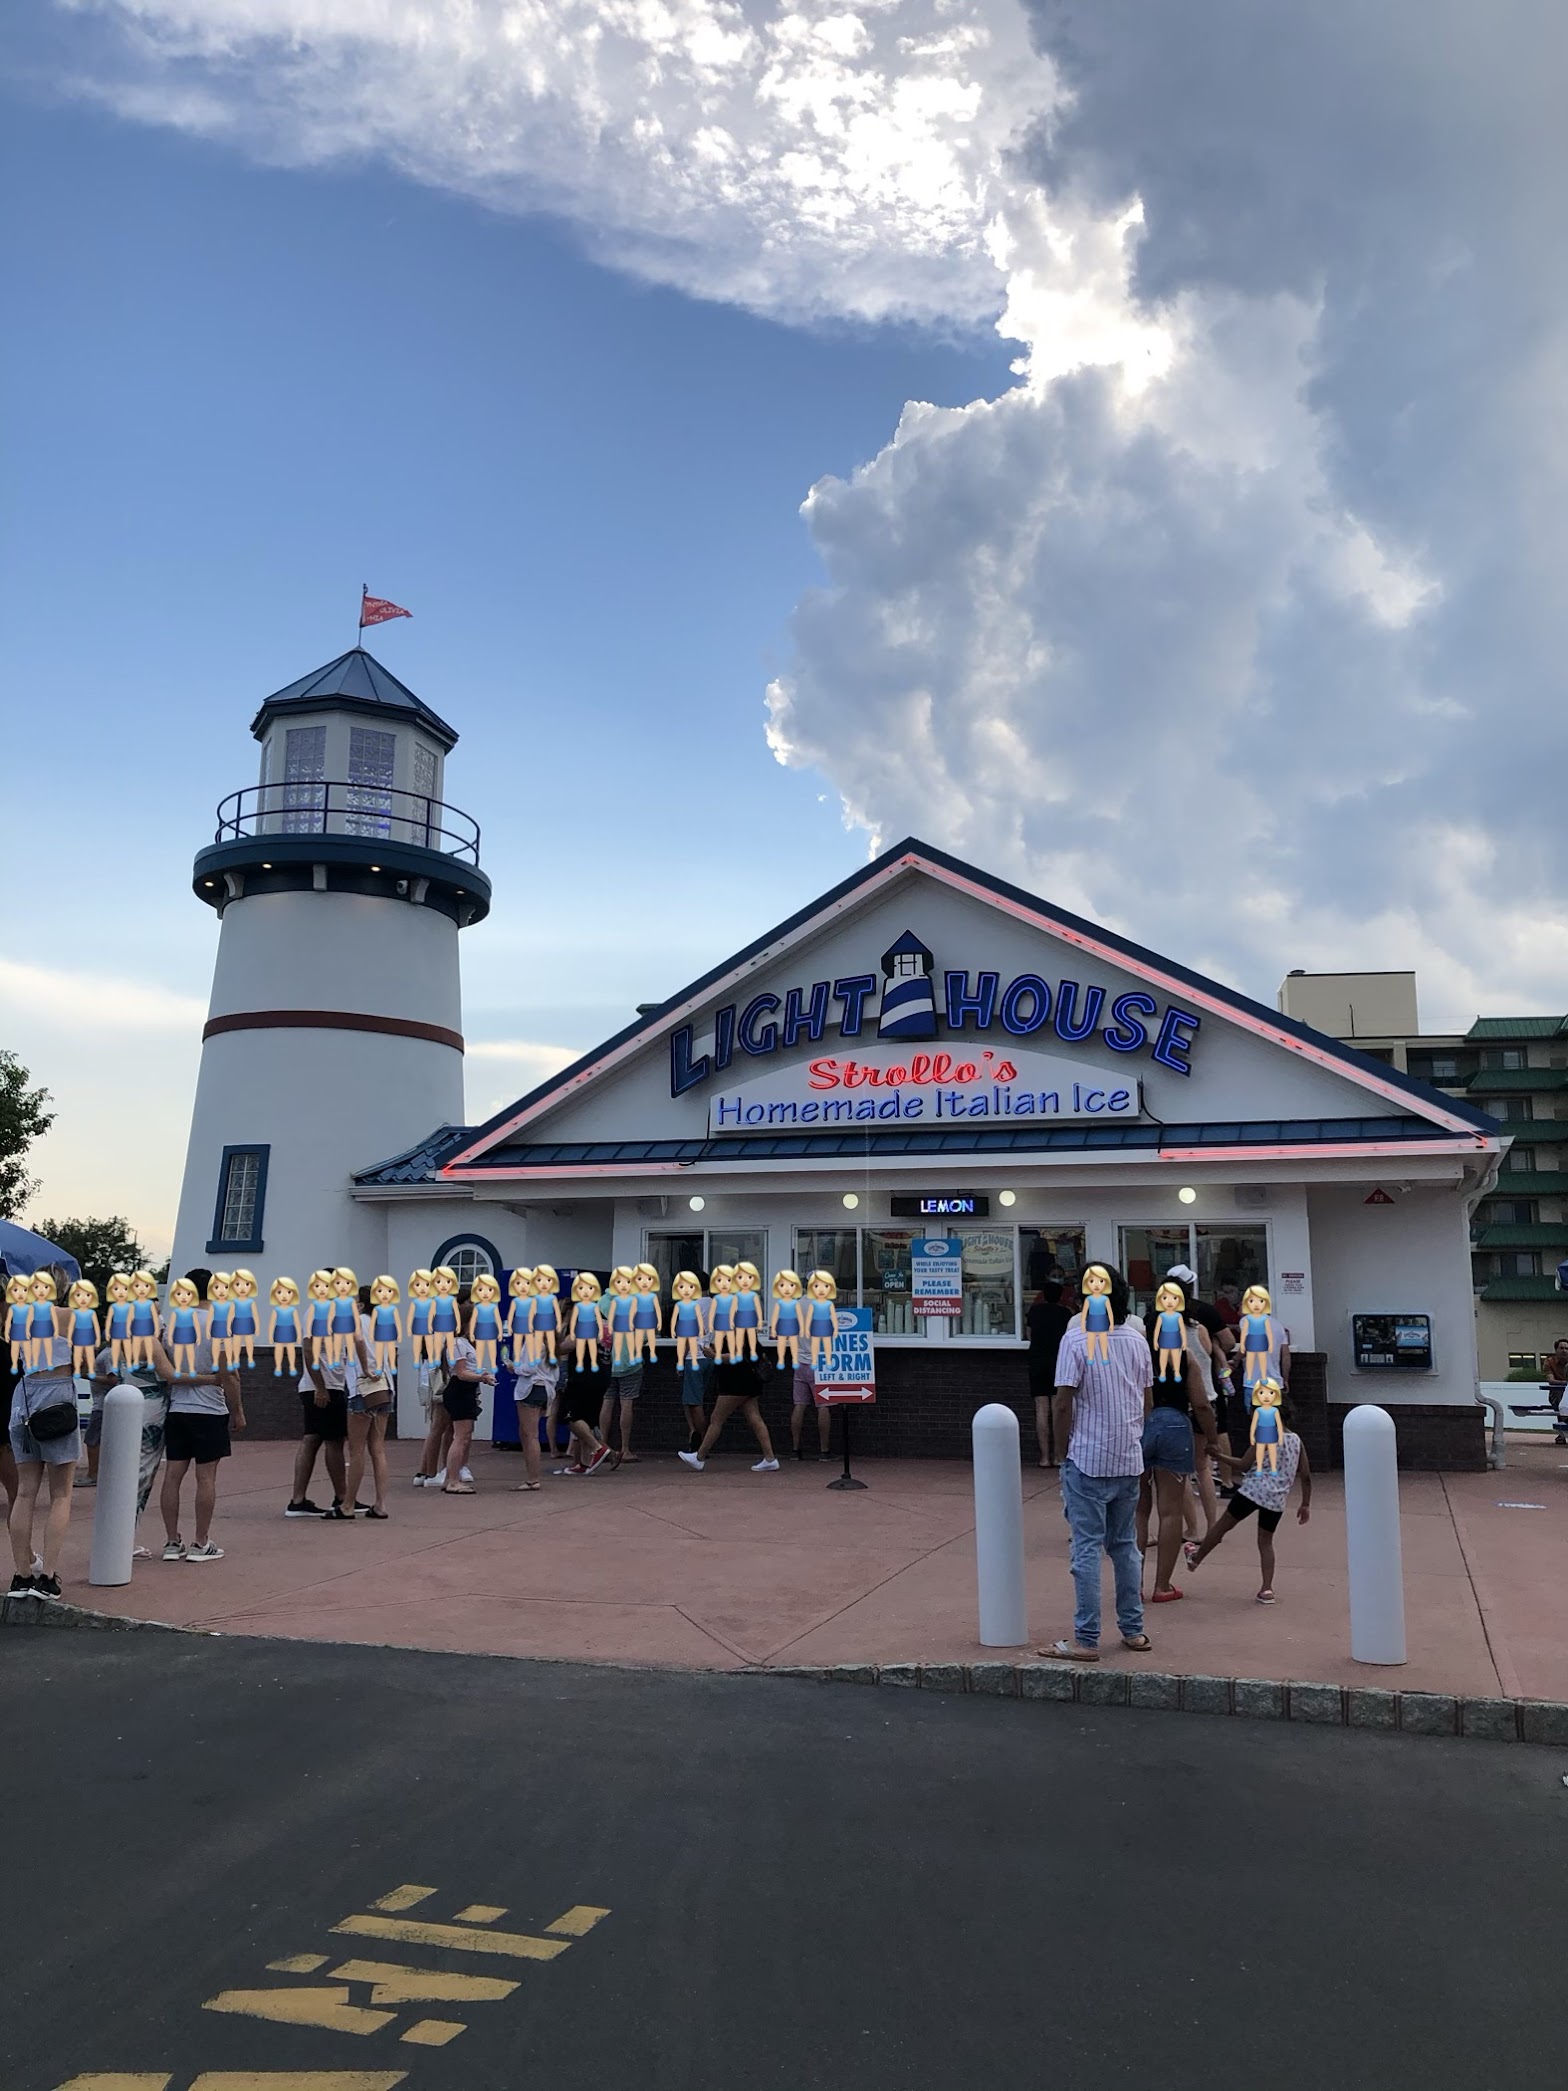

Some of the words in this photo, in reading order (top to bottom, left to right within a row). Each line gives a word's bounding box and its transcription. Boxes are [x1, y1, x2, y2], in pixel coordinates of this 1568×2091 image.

[671, 973, 876, 1099] LIGHT
[944, 970, 1201, 1077] HOUSE
[808, 1051, 1018, 1090] Strollo's
[718, 1089, 924, 1125] Homemade
[935, 1084, 1060, 1118] Italian
[1073, 1082, 1130, 1113] Ice
[920, 1199, 974, 1213] LEMON
[820, 1373, 835, 1381] LEFT
[838, 1373, 845, 1381] &
[847, 1372, 871, 1381] RIGHT
